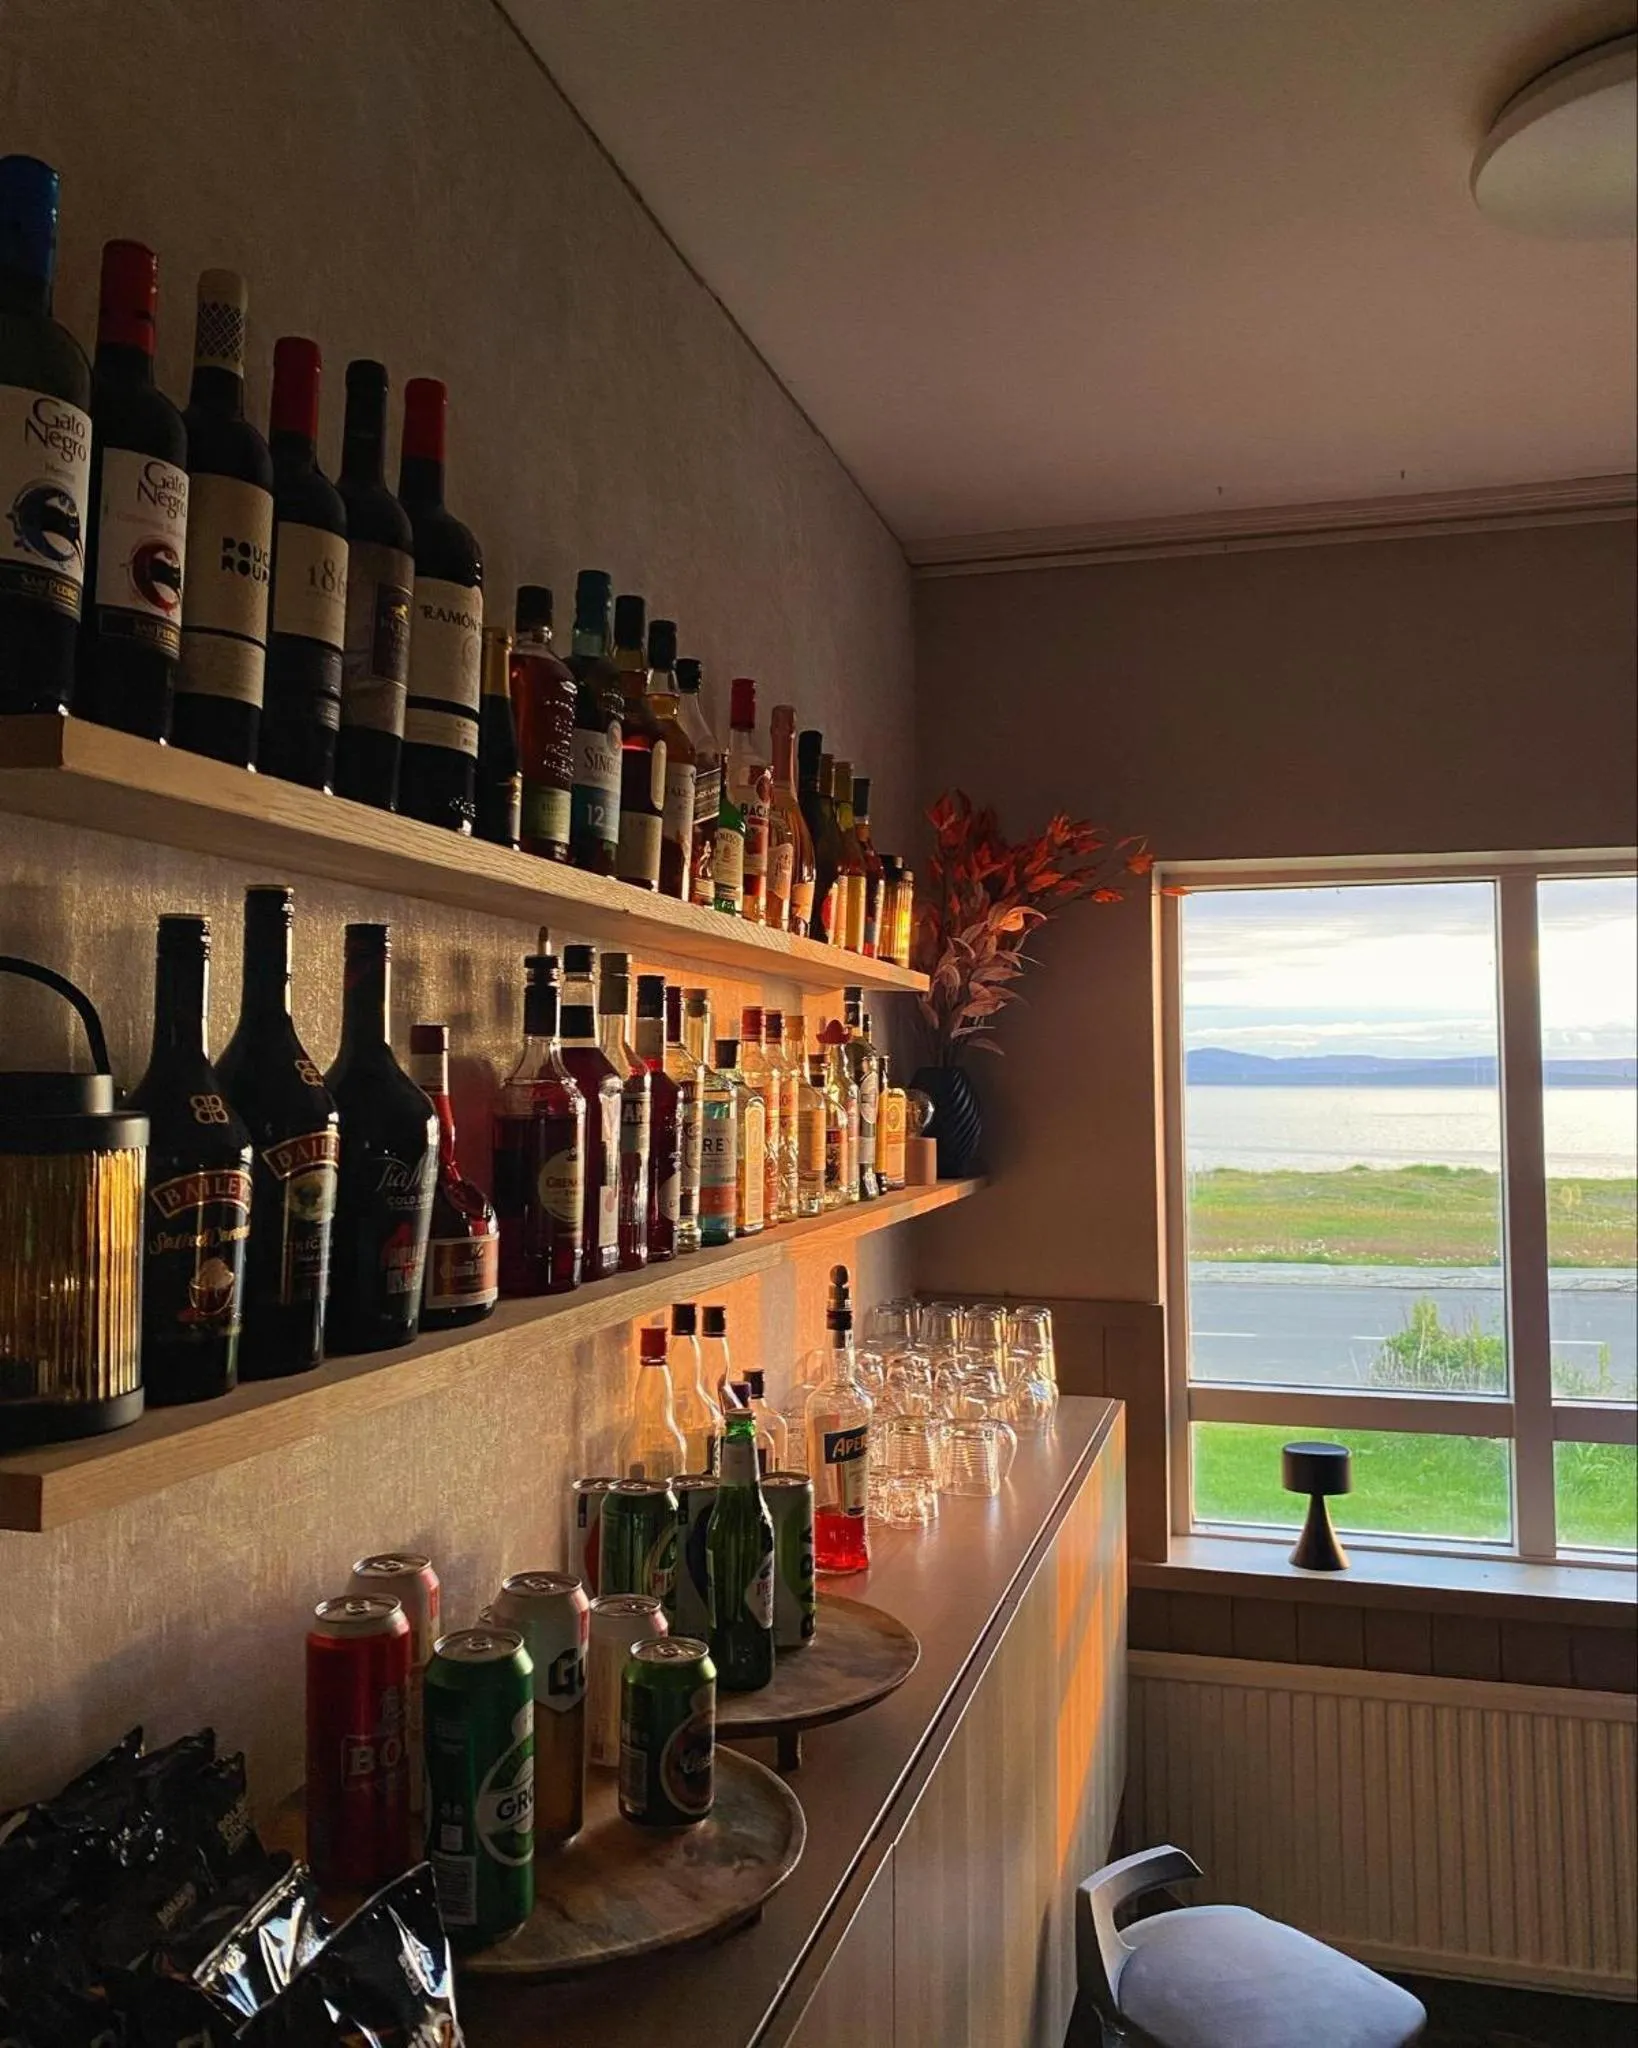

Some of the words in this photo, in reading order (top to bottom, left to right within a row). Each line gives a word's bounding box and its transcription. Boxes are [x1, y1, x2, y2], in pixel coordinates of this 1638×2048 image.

[33, 398, 86, 438] Gato
[25, 418, 87, 463] Negro
[145, 462, 187, 496] Gato
[138, 481, 187, 519] Negro
[587, 803, 605, 826] 12
